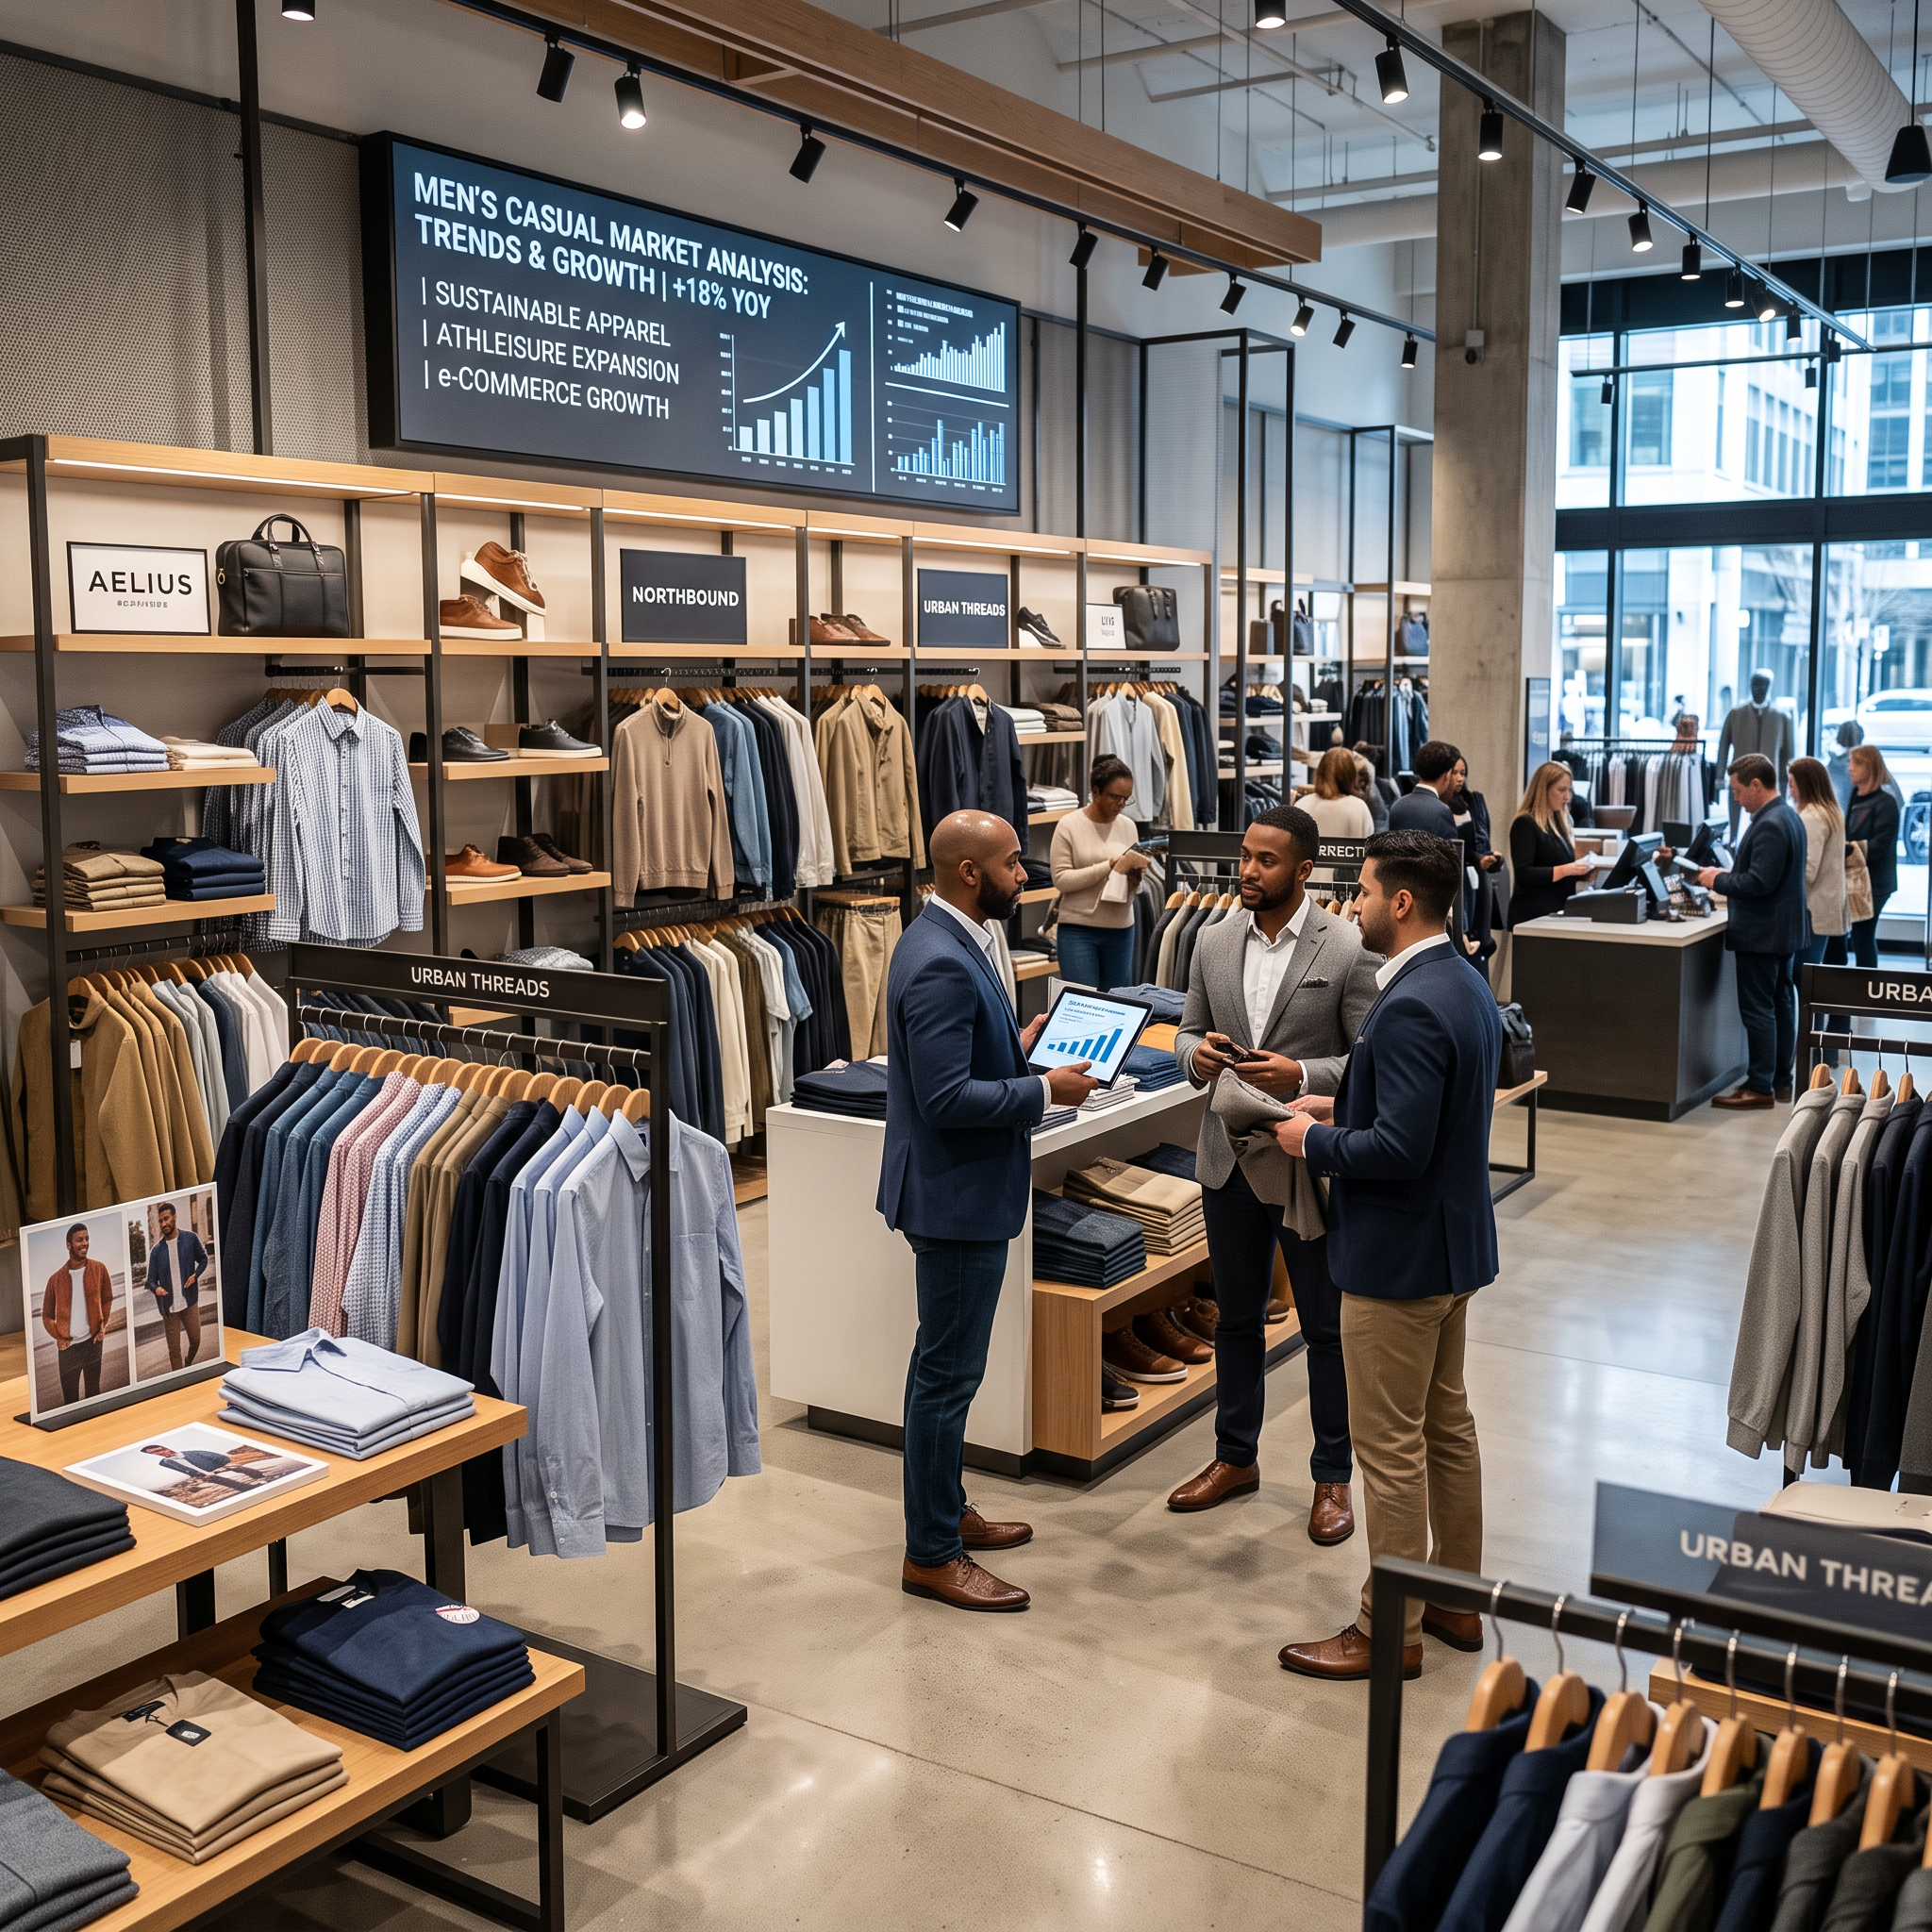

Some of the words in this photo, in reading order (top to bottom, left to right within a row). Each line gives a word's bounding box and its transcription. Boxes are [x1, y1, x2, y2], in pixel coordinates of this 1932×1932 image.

[414, 172, 498, 220] MEN'S
[505, 196, 604, 245] CASUAL
[609, 221, 703, 269] MARKET
[707, 247, 808, 295] ANALYSIS:
[414, 212, 522, 264] TRENDS
[528, 240, 547, 271] &
[552, 245, 656, 295] GROWTH
[673, 276, 727, 310] +18%
[731, 287, 772, 319] YOY
[435, 280, 581, 330] SUSTAINABLE
[585, 310, 671, 347] APPAREL
[436, 322, 567, 366] ATHLEISURE
[573, 345, 679, 385] EXPANSION
[438, 366, 582, 407] e-COMMERCE
[586, 386, 670, 420] GROWTH
[88, 570, 192, 595] AELIUS
[632, 586, 740, 607] NORTHBOUND
[924, 600, 959, 614] URBAN
[960, 601, 1006, 617] THREADS
[410, 966, 466, 989] URBAN
[471, 973, 550, 998] THREADS
[1680, 1529, 1807, 1581] URBAN
